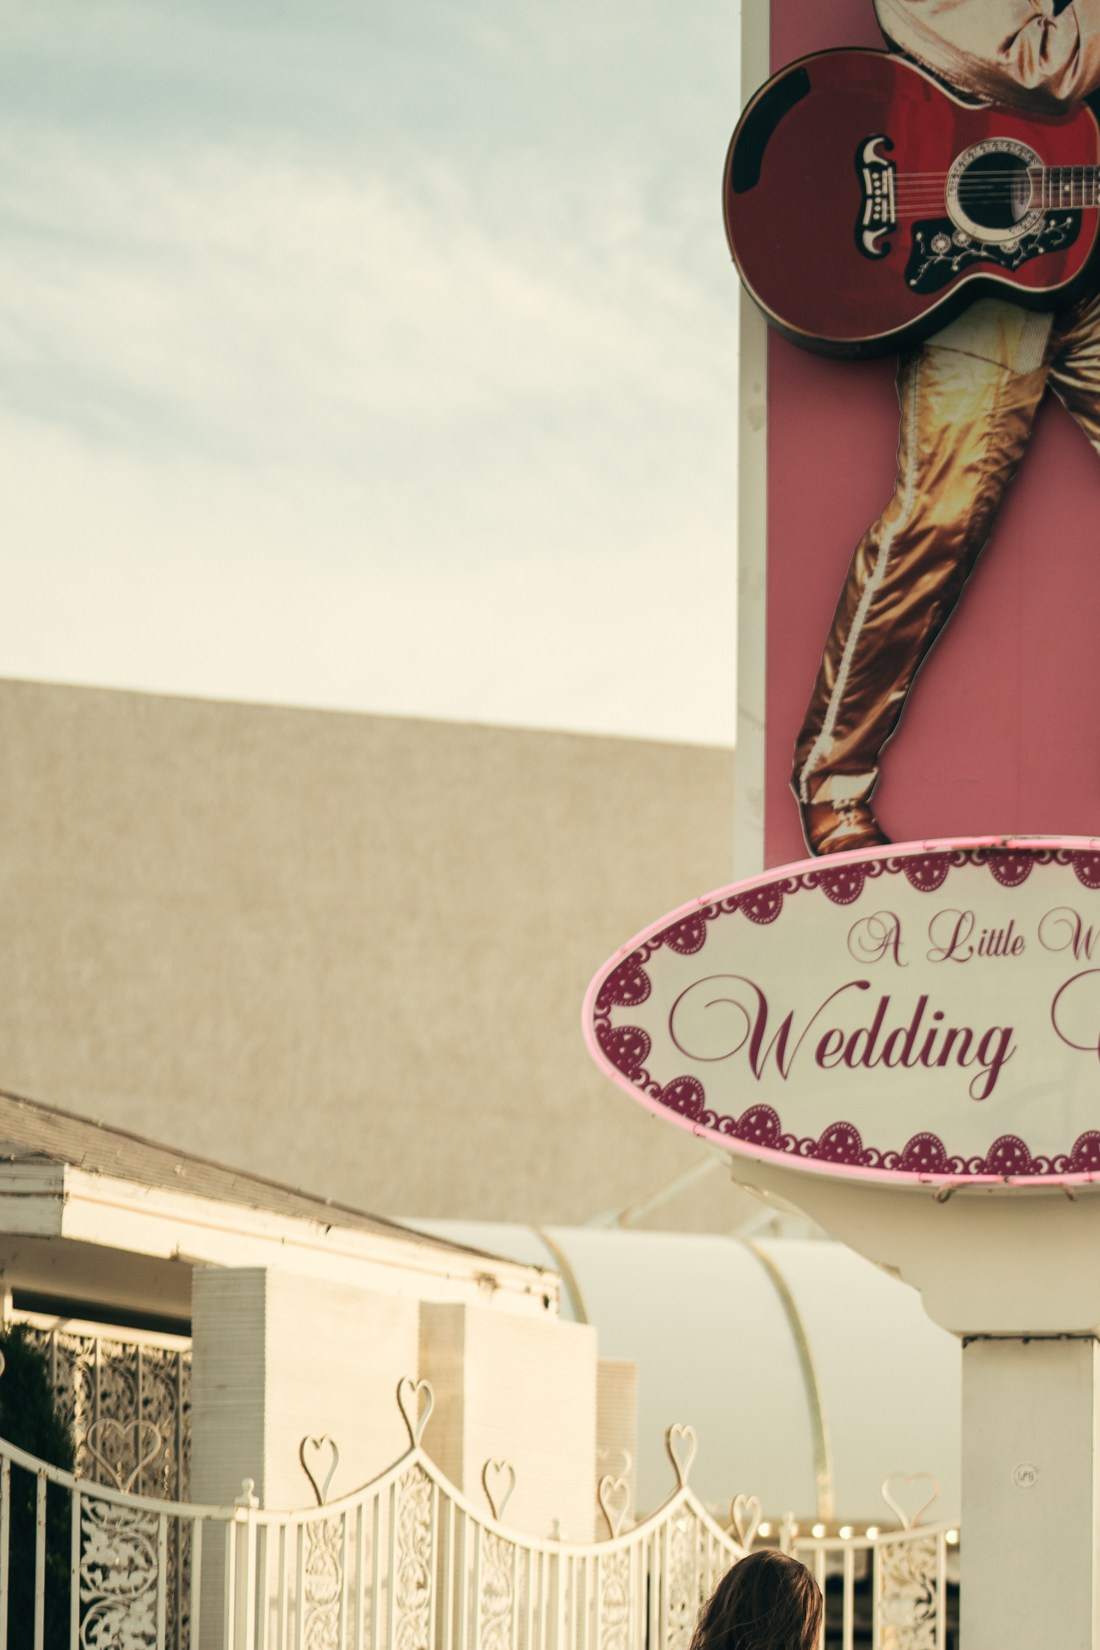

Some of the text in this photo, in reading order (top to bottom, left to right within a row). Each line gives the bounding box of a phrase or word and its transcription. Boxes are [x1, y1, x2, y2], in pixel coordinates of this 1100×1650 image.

[847, 910, 910, 968] A
[926, 908, 1026, 963] Little
[668, 973, 1017, 1101] Wedding
